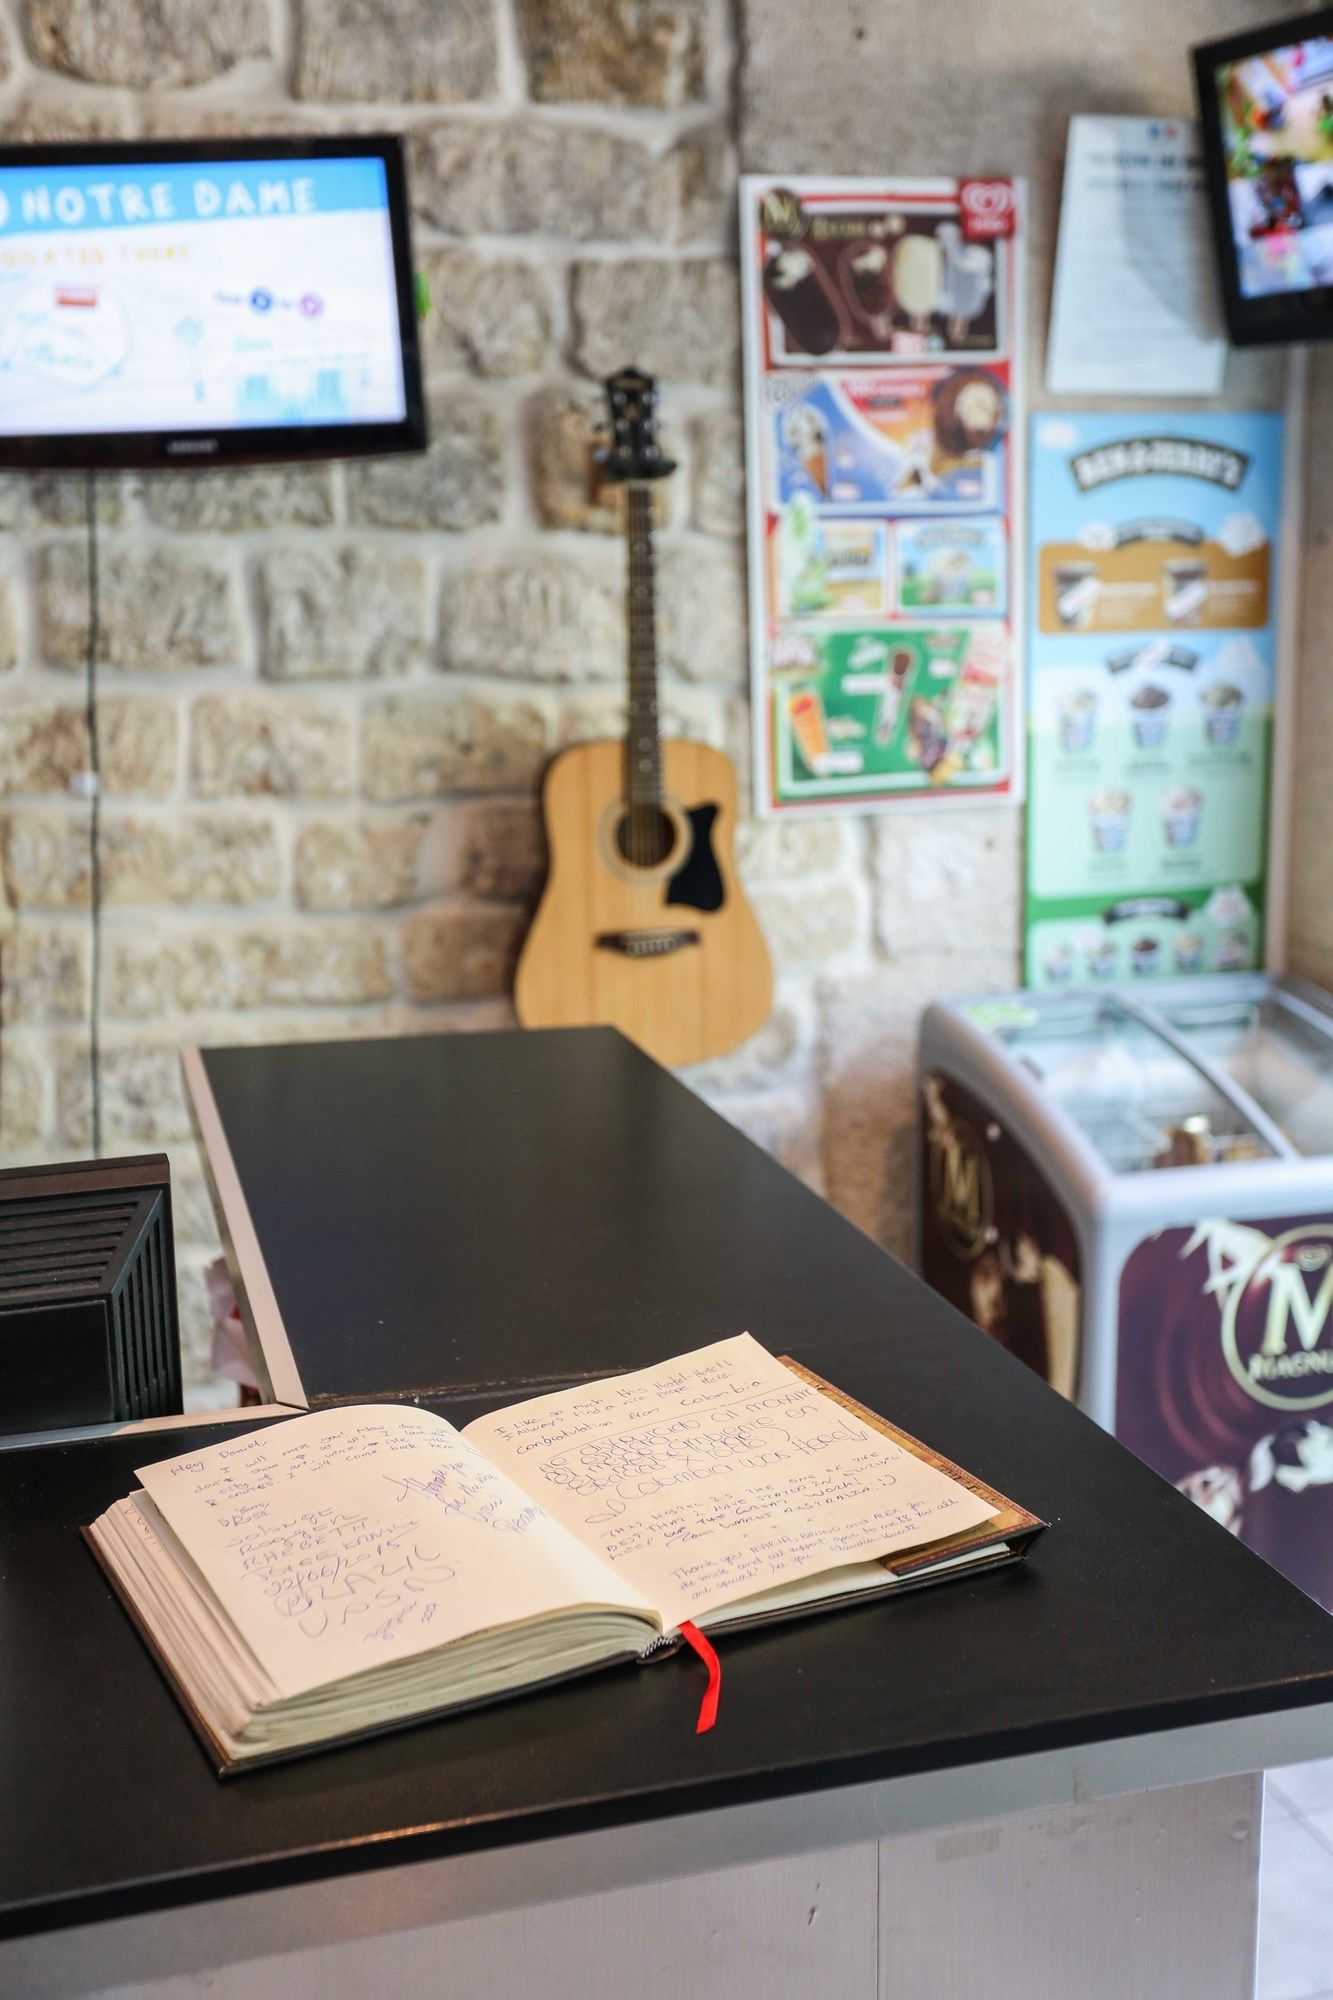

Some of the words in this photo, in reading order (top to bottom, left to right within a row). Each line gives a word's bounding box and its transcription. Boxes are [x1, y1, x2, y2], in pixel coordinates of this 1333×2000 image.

[22, 182, 178, 224] NOTRE
[193, 178, 318, 218] DAME
[345, 1449, 378, 1462] come
[170, 1461, 205, 1477] Hey
